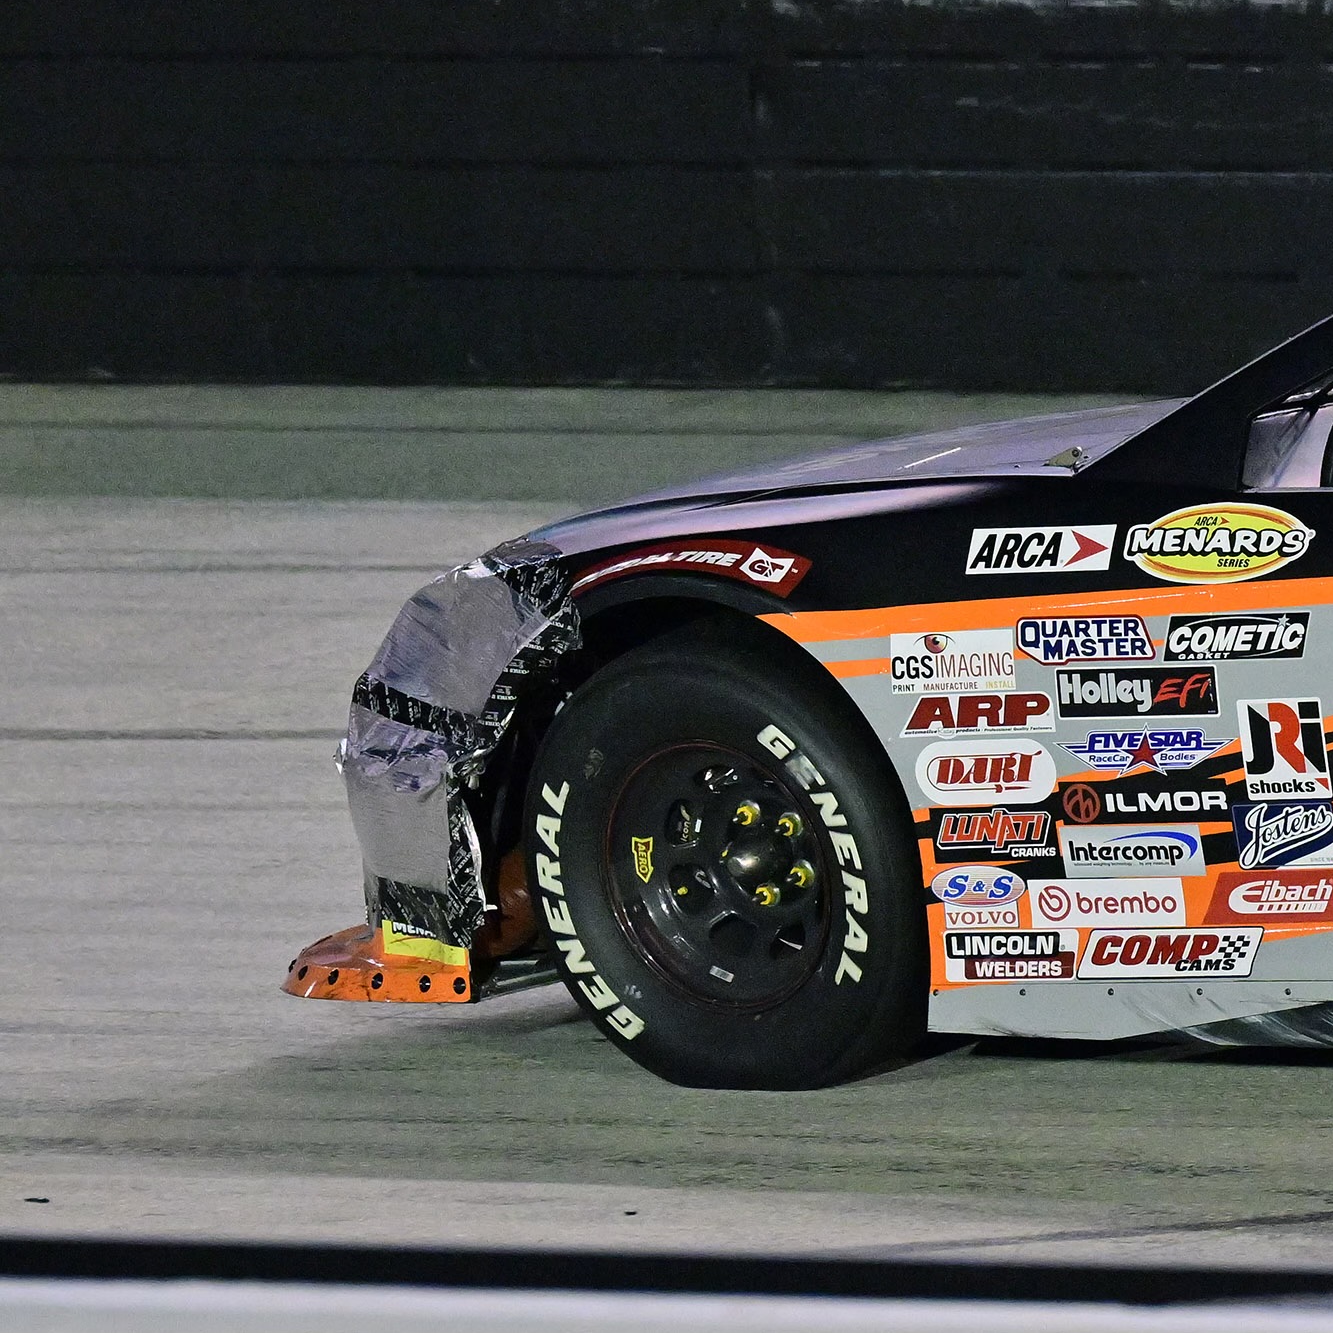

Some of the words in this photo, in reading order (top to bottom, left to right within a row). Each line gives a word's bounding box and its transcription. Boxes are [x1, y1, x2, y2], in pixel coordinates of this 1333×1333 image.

[1194, 516, 1219, 527] ARCA
[969, 531, 1064, 570] ARCA
[1129, 528, 1307, 557] MENARDS
[675, 550, 743, 567] TIRE
[1217, 558, 1251, 568] SERIES
[1020, 619, 1142, 650] QUARTER
[1168, 621, 1305, 653] COMETIC
[1043, 637, 1147, 661] MASTER
[1178, 652, 1231, 661] GASKET
[892, 684, 916, 693] PRINT
[923, 681, 979, 691] MANUFACTURE
[985, 680, 1016, 690] INSTALL
[1059, 672, 1152, 713] Holley
[906, 693, 1051, 731] ARP
[1087, 732, 1142, 752] FIVE
[1148, 730, 1204, 750] STAR
[936, 749, 1043, 785] DART
[1159, 752, 1197, 762] Bodies
[1248, 777, 1317, 795] shocks
[1104, 790, 1229, 813] ILMOR
[940, 811, 1046, 849] LUNATI
[1240, 803, 1332, 868] Jostens
[636, 843, 649, 876] AERO
[757, 724, 869, 986] GENERAL
[1010, 847, 1057, 857] CRANKS
[1068, 840, 1184, 866] Intercomp
[943, 874, 970, 898] S
[972, 880, 986, 893] &
[988, 874, 1014, 899] S
[535, 781, 647, 1041] GENERAL
[1076, 891, 1178, 915] brembo
[947, 910, 1018, 926] VOLVO
[950, 935, 1056, 956] LINCOLN
[1091, 934, 1221, 966] COMP
[974, 960, 1063, 978] WELDERS
[1174, 959, 1236, 972] CAMS
